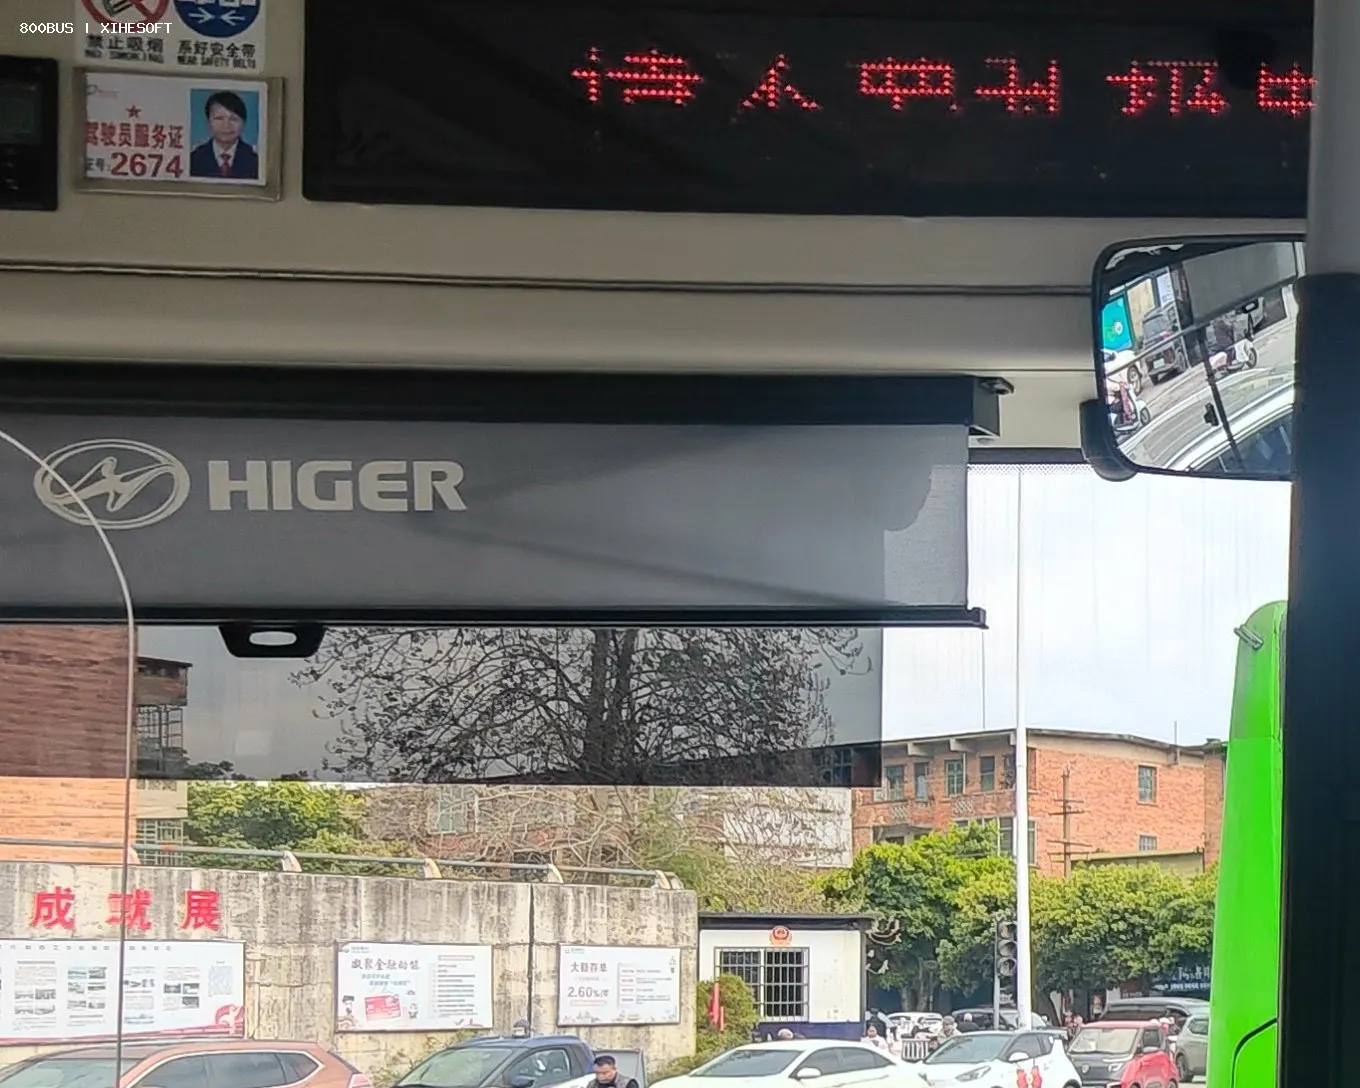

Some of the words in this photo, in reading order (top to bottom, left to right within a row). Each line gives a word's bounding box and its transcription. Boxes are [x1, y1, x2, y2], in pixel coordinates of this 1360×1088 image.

[178, 40, 256, 58] 系好安全带
[86, 121, 184, 150] 驾驶员服务证
[110, 152, 184, 179] 2674
[208, 460, 467, 511] HIGER
